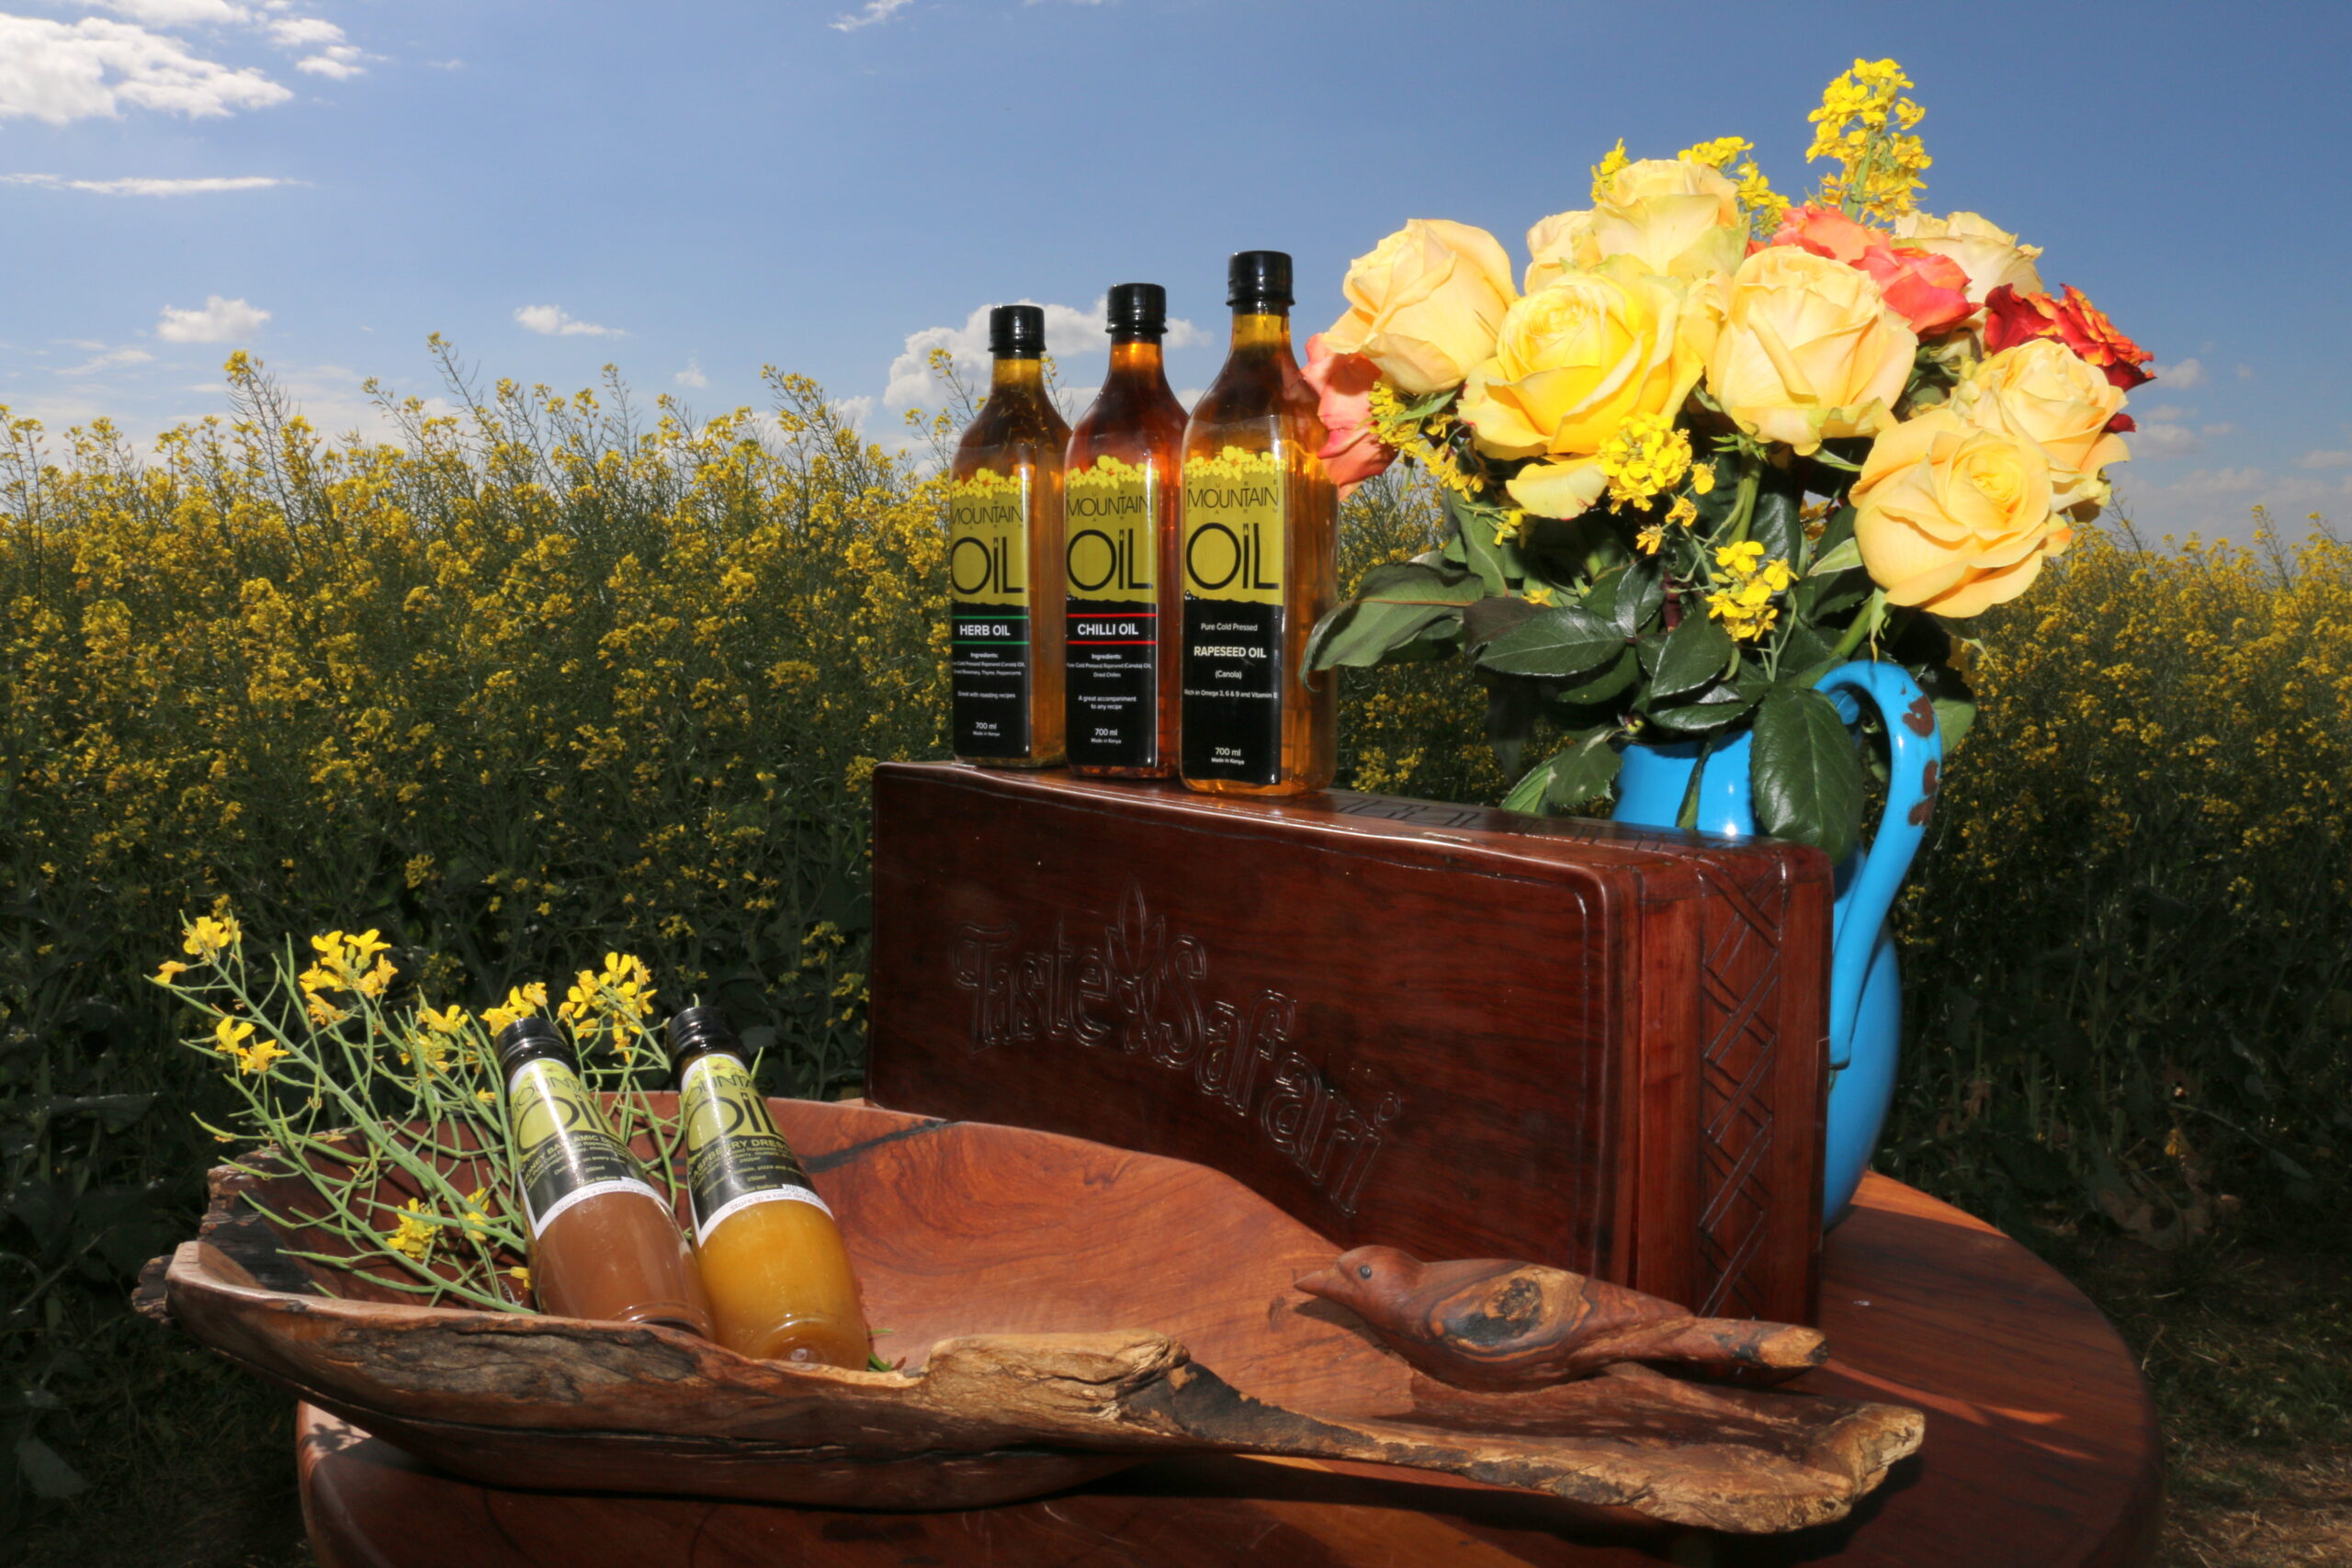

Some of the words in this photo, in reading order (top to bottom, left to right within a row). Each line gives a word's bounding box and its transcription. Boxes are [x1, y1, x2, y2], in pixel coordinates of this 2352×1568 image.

[1187, 487, 1279, 508] MOUNTAIN
[1067, 495, 1153, 516] MOUNTAIN
[952, 505, 1023, 525] MOUNTAIN
[959, 625, 990, 637] HERB
[992, 625, 1011, 637] OIL
[1077, 623, 1116, 636] CHILLI
[1118, 623, 1139, 636] OIL
[1201, 623, 1216, 631] Pure
[1216, 623, 1232, 631] Cold
[1233, 624, 1259, 632] Pressed
[1193, 646, 1247, 658] RAPESEED
[1248, 648, 1267, 659] OIL
[1215, 670, 1242, 680] (Canola)
[1094, 728, 1109, 736] 700
[951, 913, 1110, 1055] Taste
[1148, 935, 1404, 1217] Safari
